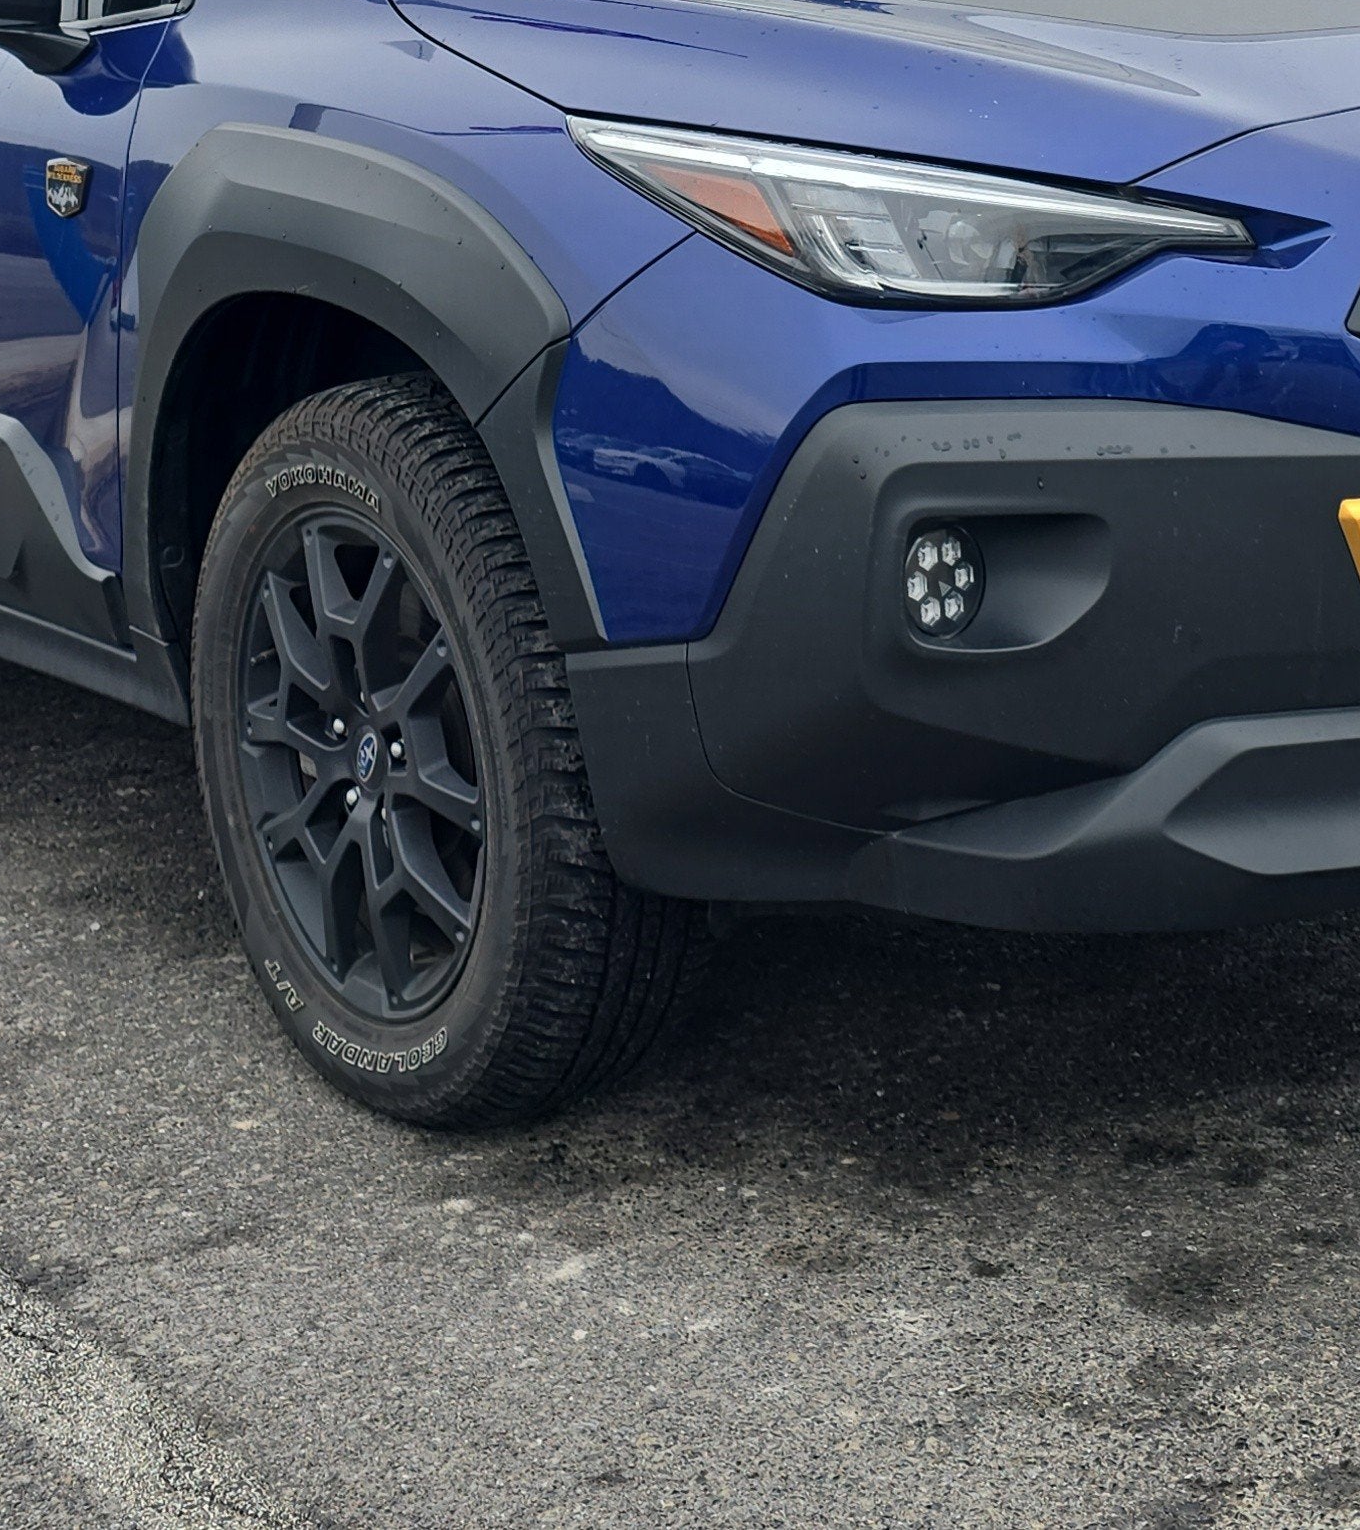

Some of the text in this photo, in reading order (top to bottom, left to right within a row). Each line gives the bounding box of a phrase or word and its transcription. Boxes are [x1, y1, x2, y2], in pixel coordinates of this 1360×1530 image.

[265, 463, 379, 514] YOKOHAMA
[264, 959, 448, 1074] GEOLANDAR A/T
